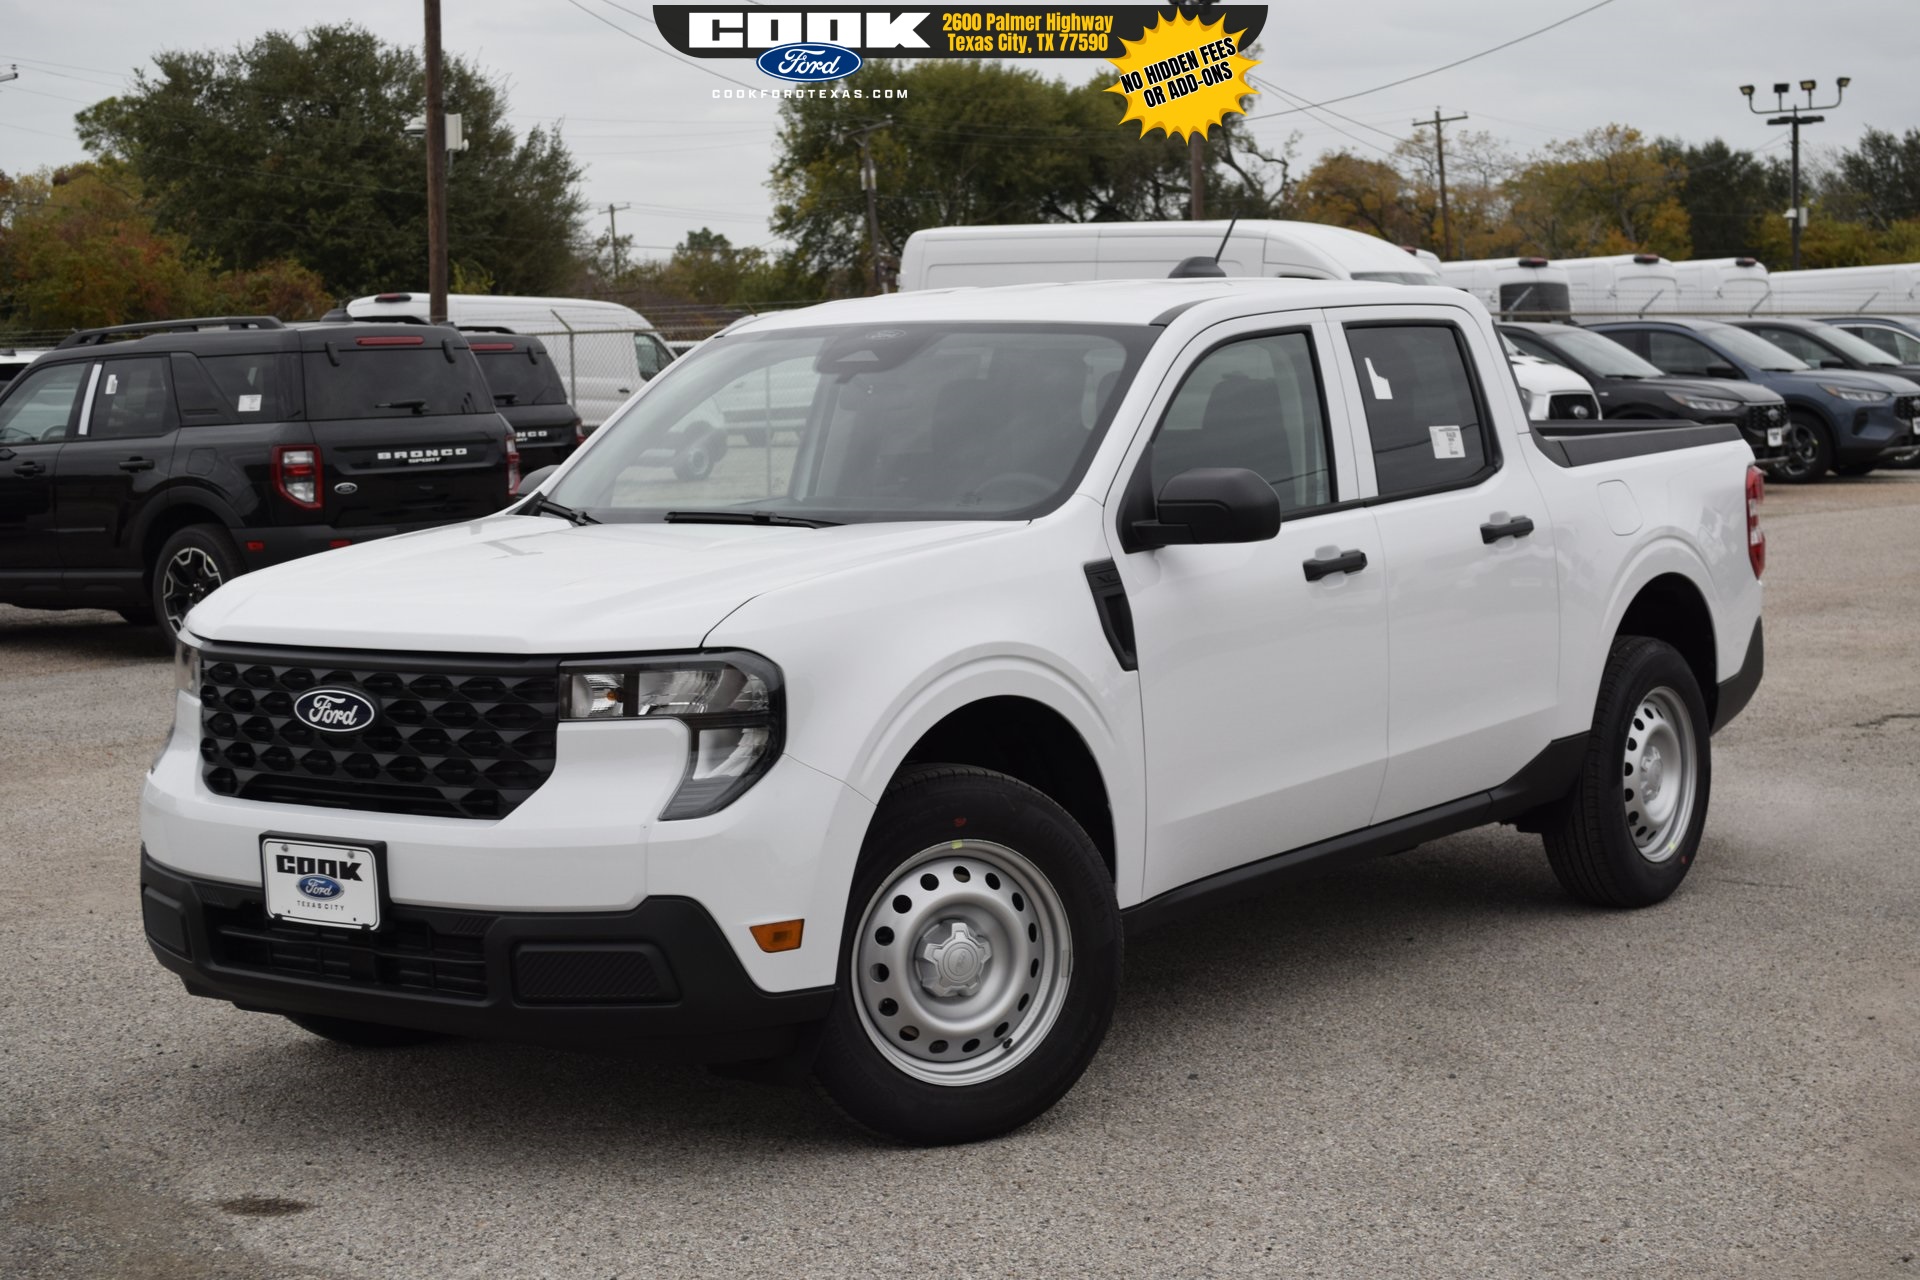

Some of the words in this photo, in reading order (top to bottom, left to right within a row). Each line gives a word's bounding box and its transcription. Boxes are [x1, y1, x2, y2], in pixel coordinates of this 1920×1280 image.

[377, 447, 468, 460] BRONCO
[309, 695, 358, 725] Ford
[276, 854, 363, 882] COOK
[305, 878, 333, 896] Ford
